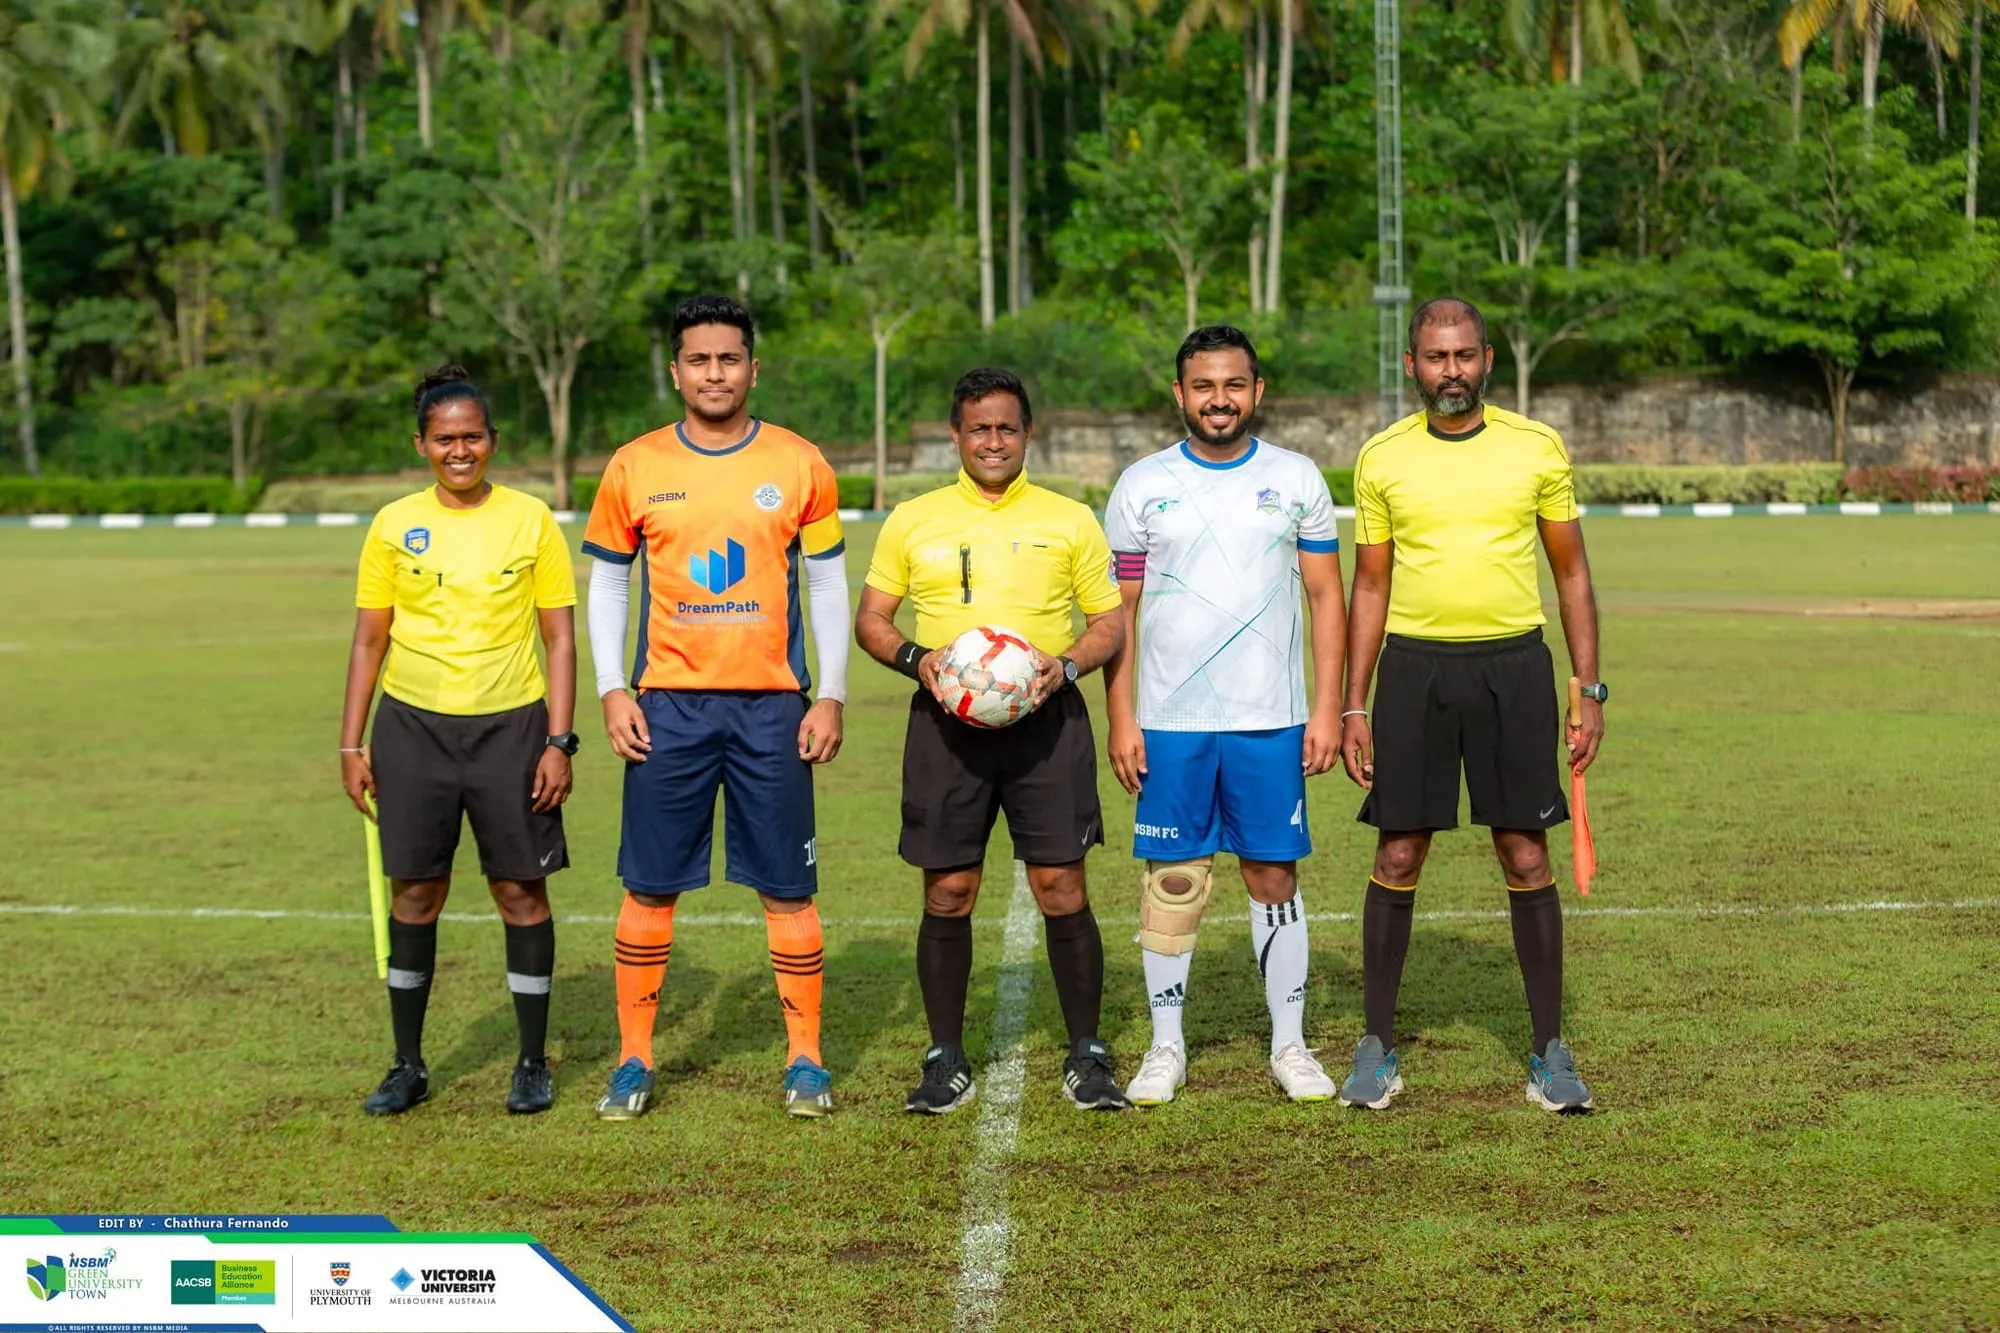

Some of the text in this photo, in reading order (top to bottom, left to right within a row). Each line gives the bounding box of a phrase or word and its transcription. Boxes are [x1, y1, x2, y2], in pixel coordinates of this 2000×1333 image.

[648, 491, 686, 504] NSBM
[677, 600, 760, 613] DreamPath
[1290, 798, 1303, 834] 4
[1162, 827, 1178, 839] FC
